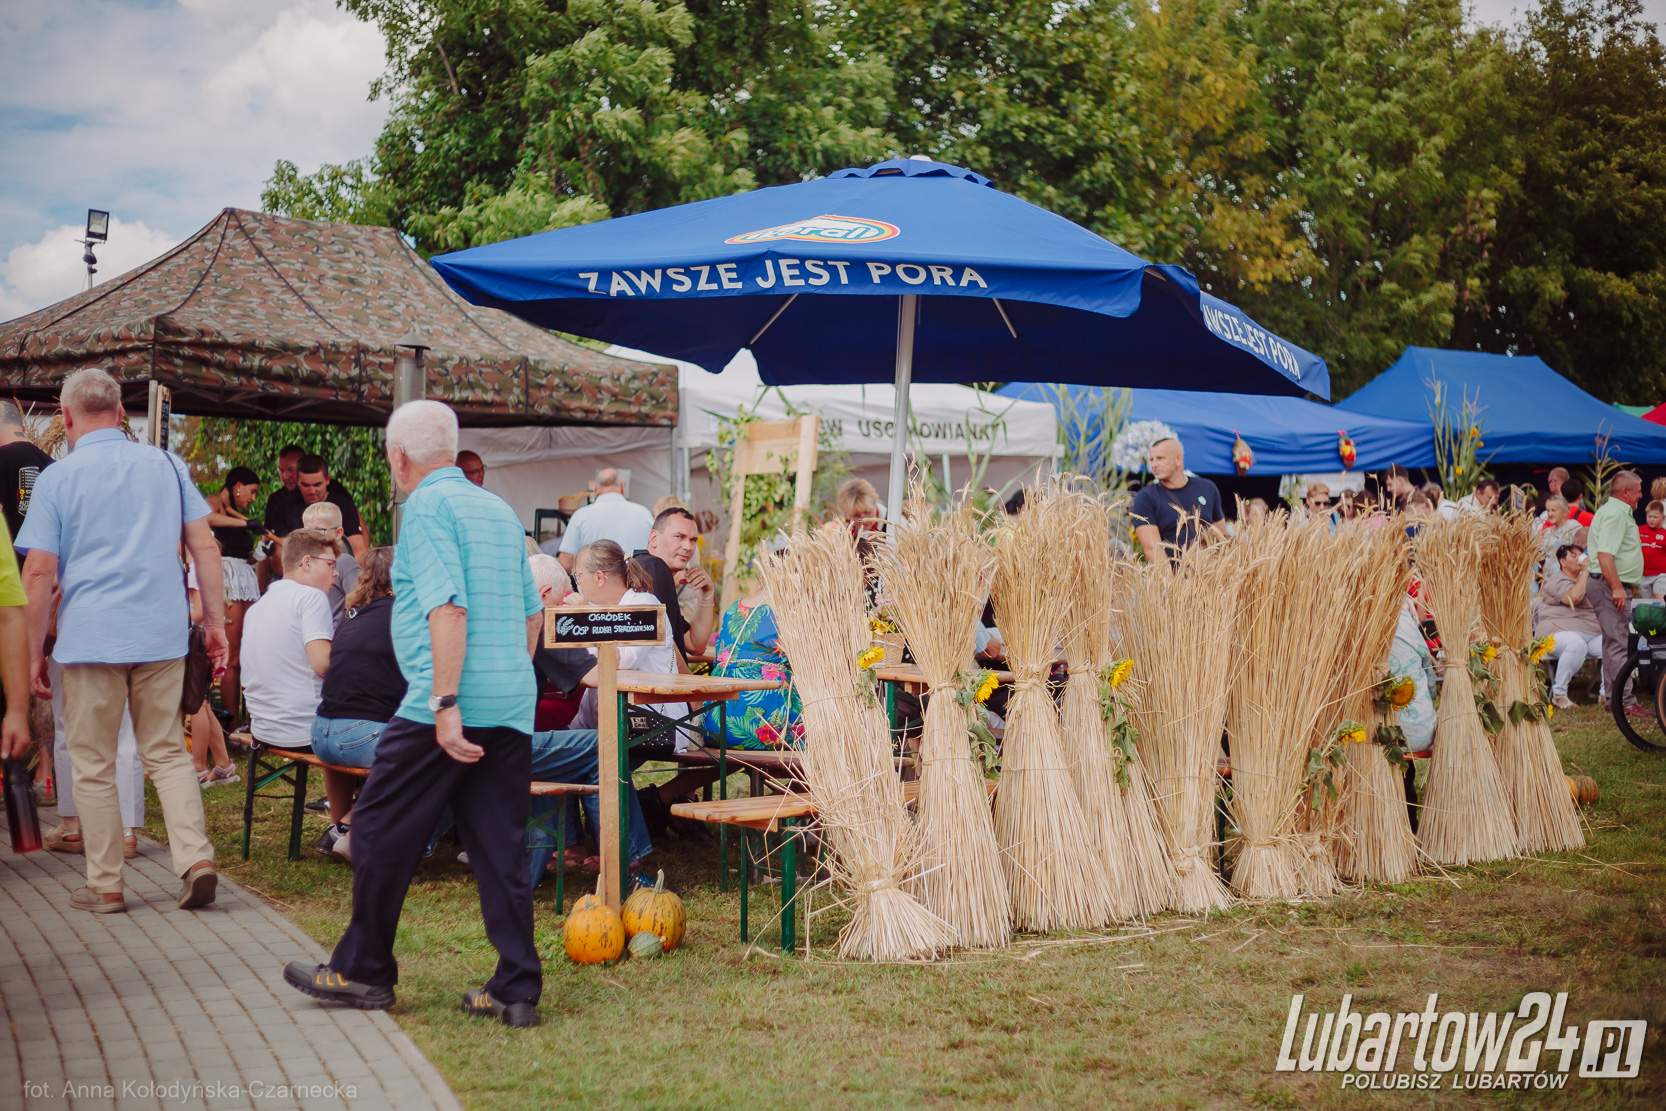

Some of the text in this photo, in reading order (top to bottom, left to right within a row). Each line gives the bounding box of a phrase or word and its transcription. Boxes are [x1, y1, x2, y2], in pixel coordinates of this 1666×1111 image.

[578, 257, 989, 297] ZAWSZE JEST PORA
[588, 611, 632, 622] OGRÓDEK
[572, 625, 589, 636] OSP
